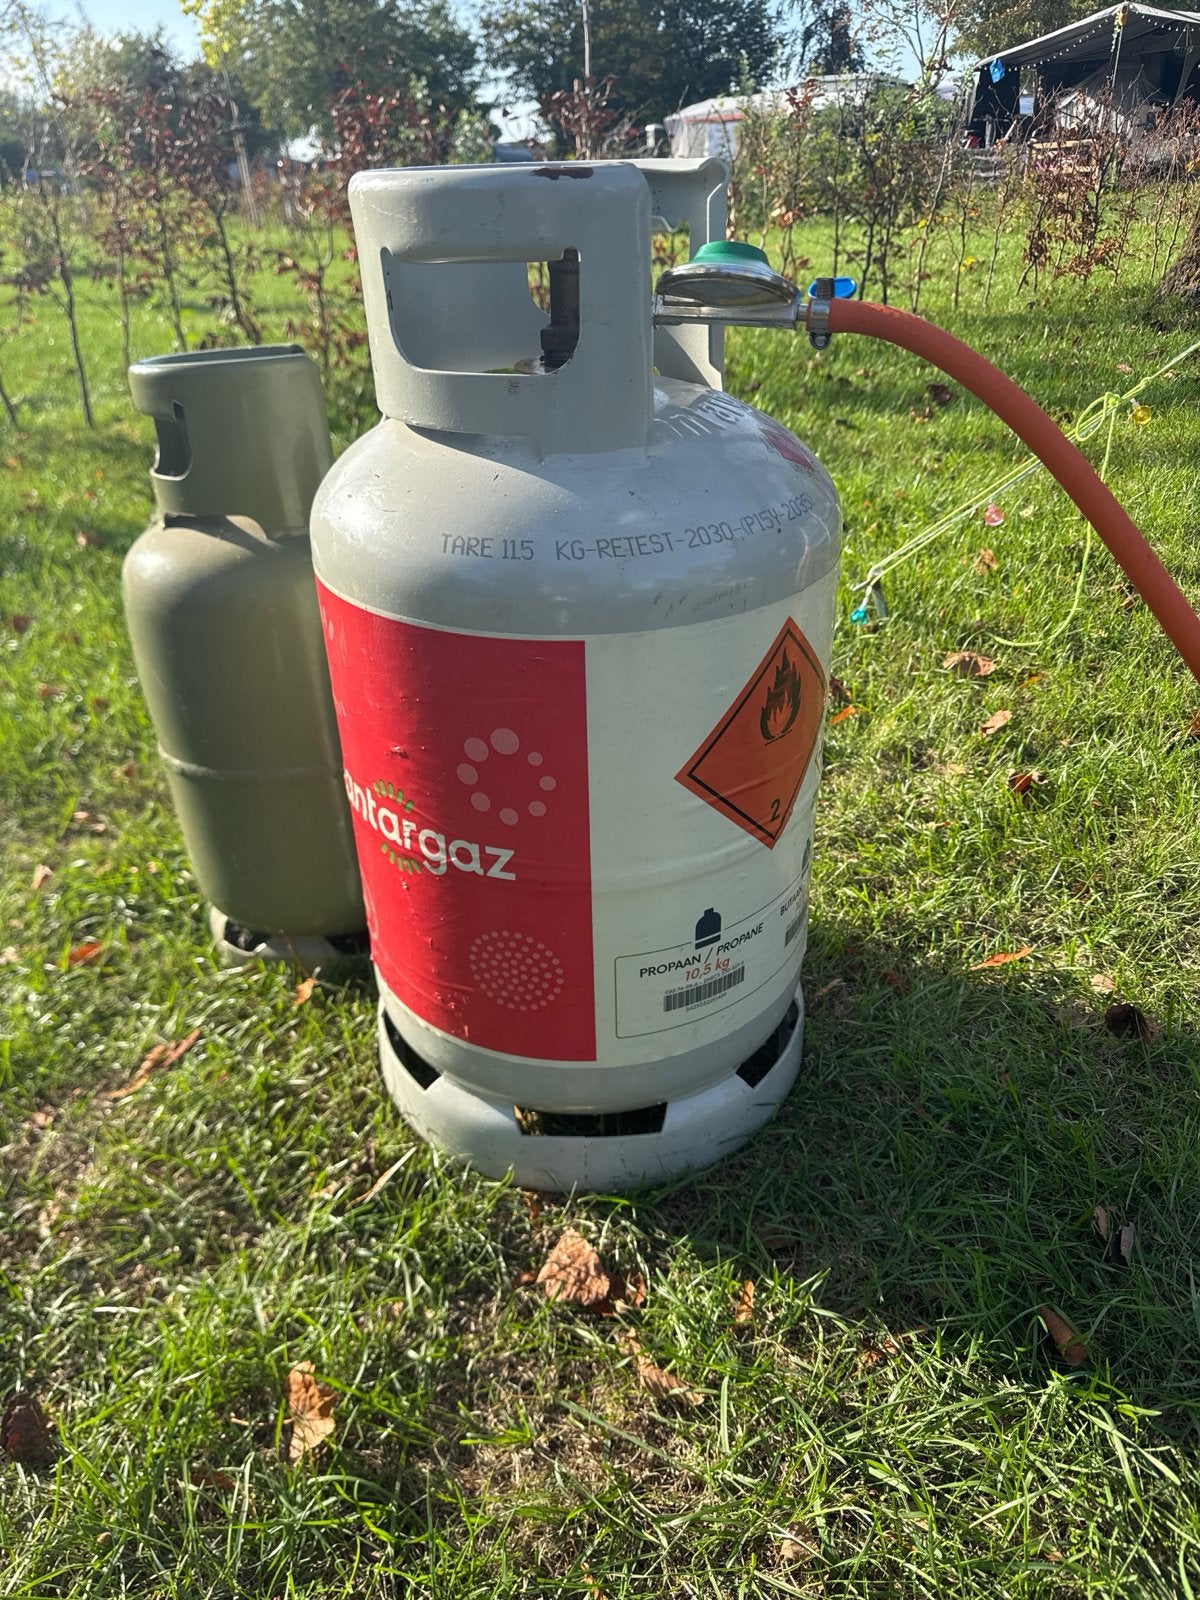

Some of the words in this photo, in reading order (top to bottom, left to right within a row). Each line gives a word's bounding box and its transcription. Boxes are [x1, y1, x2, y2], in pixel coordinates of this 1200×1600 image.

[442, 533, 495, 559] TARE
[770, 798, 781, 823] 2
[639, 953, 702, 978] PROPAAN
[704, 947, 714, 964] /
[716, 921, 765, 956] PROPANE
[685, 962, 712, 982] 10,5
[715, 957, 731, 972] kg
